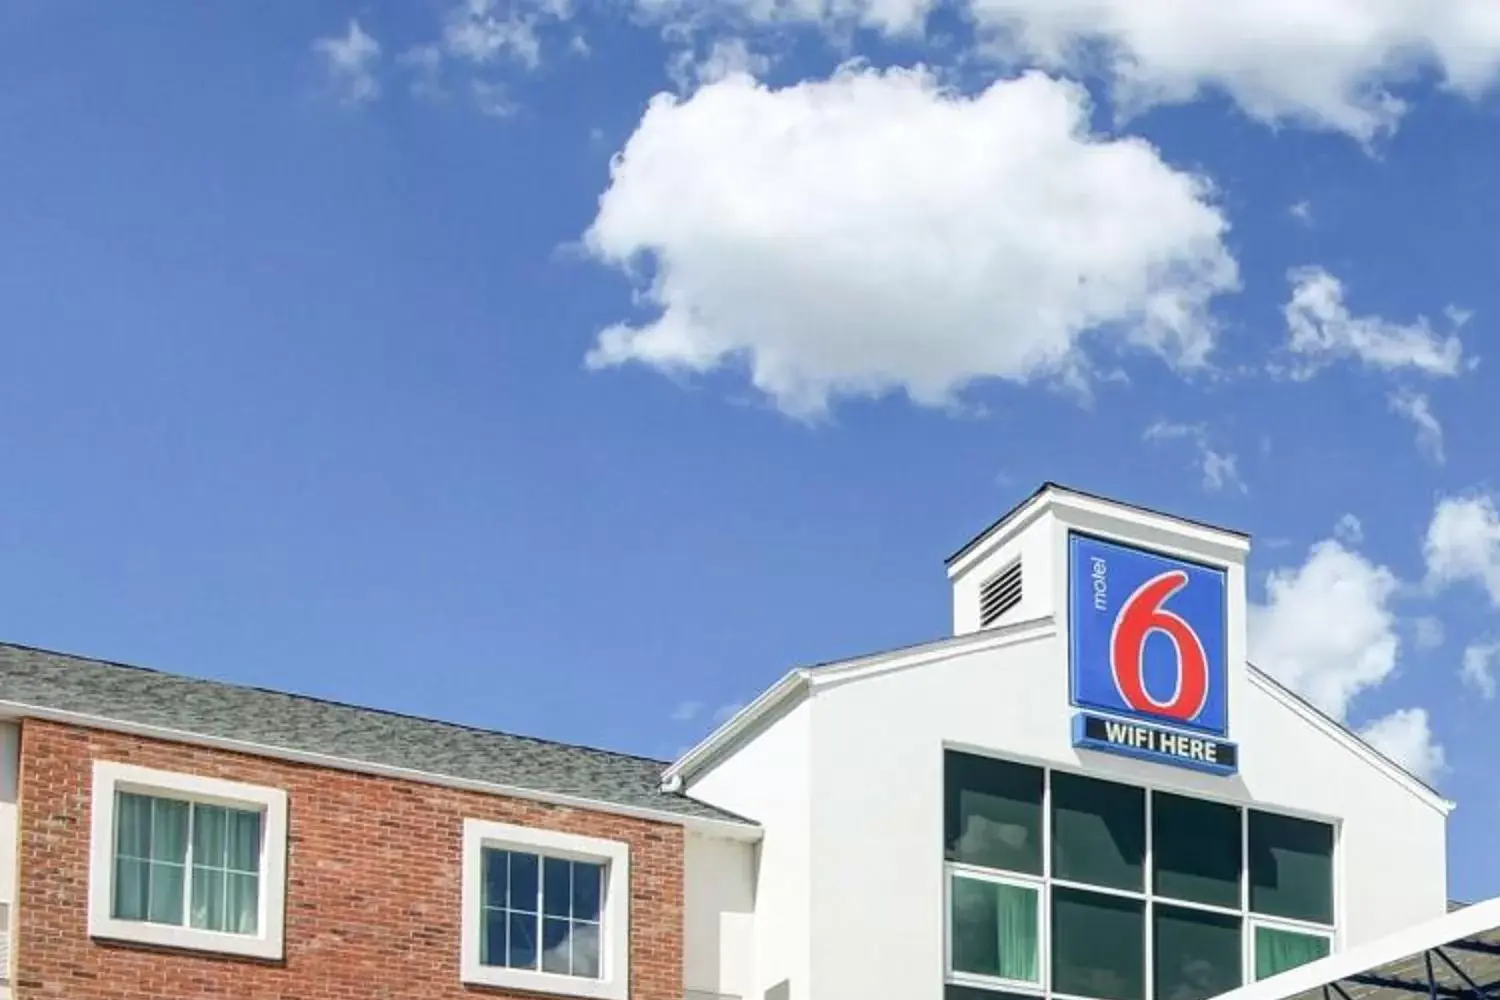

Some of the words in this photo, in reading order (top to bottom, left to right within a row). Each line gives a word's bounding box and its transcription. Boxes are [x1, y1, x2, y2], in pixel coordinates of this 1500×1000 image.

[1091, 556, 1107, 611] motel
[1109, 569, 1209, 721] 6
[1104, 720, 1155, 750] WIFI
[1160, 733, 1217, 763] HERE
